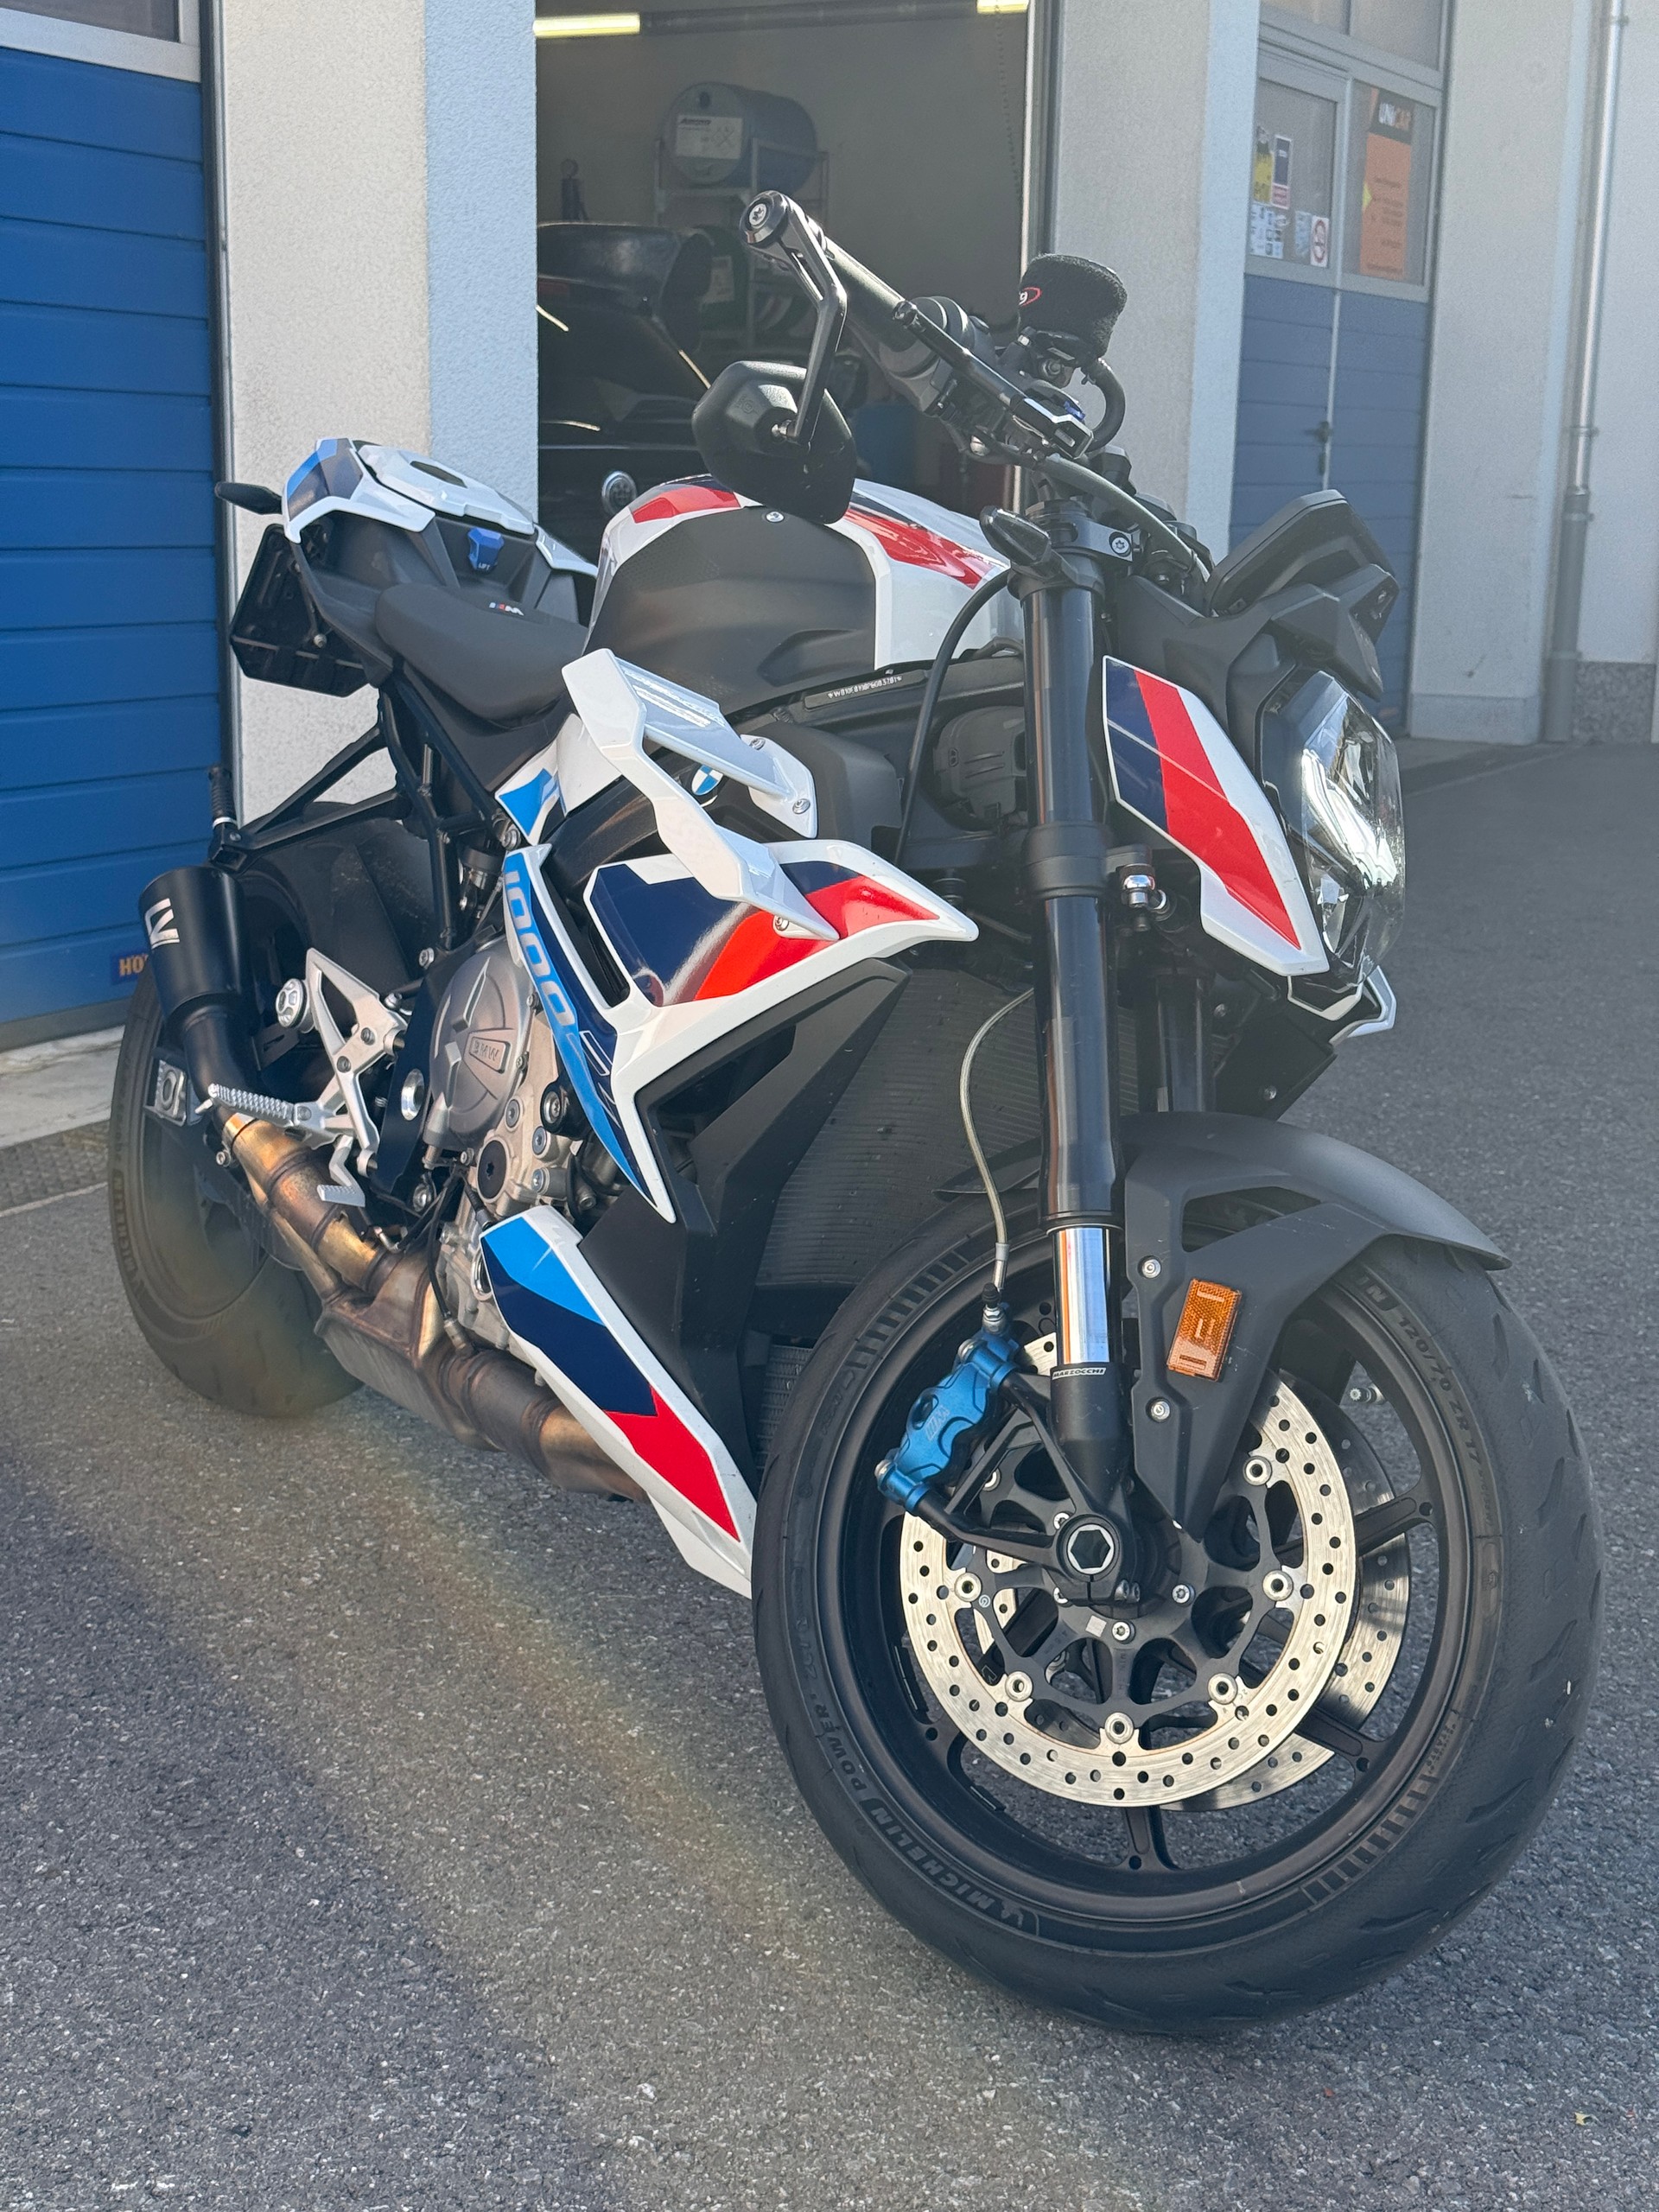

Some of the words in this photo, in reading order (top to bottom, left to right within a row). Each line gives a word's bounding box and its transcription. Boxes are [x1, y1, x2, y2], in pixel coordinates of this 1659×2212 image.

[503, 871, 575, 1027] 1000
[473, 1039, 499, 1061] BMW
[1052, 1369, 1104, 1378] MARZOCCHI
[1398, 1316, 1452, 1391] 120/70
[1465, 1439, 1481, 1465] 17
[817, 1703, 867, 1792] POWER
[869, 1807, 994, 1910] MICHELIN
